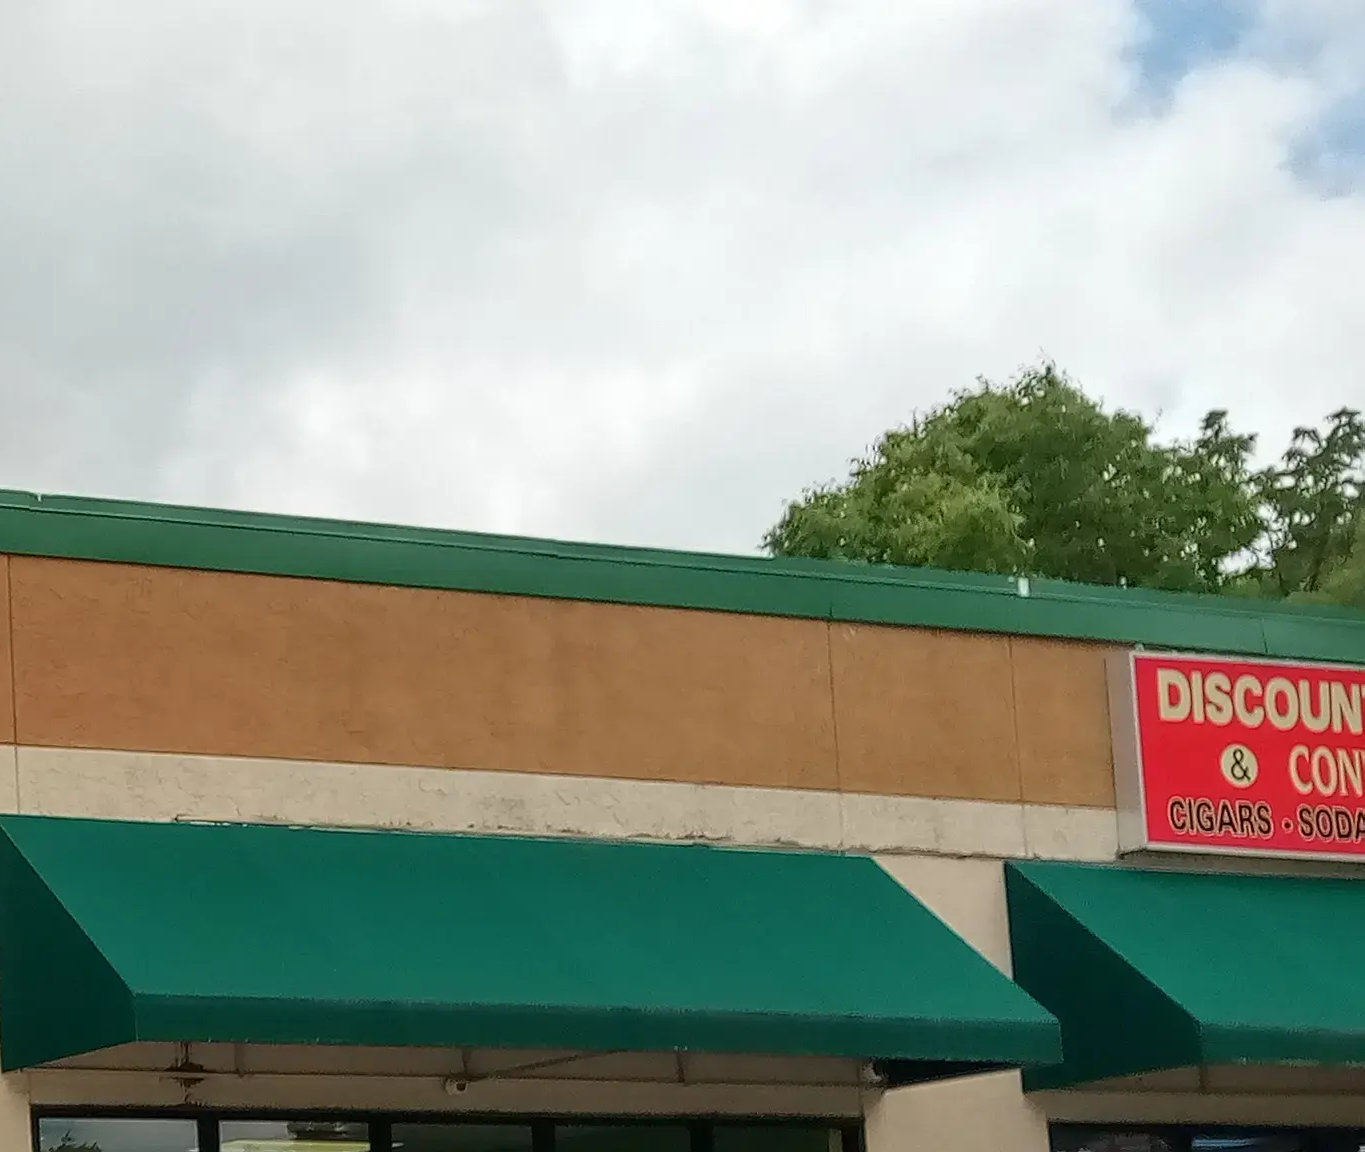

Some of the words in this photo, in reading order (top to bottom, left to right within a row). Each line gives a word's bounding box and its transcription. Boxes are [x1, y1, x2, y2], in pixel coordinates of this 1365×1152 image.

[1157, 667, 1365, 735] DISCOUN
[1230, 748, 1251, 781] &
[1288, 745, 1365, 798] CON
[1169, 797, 1273, 837] CIGARS
